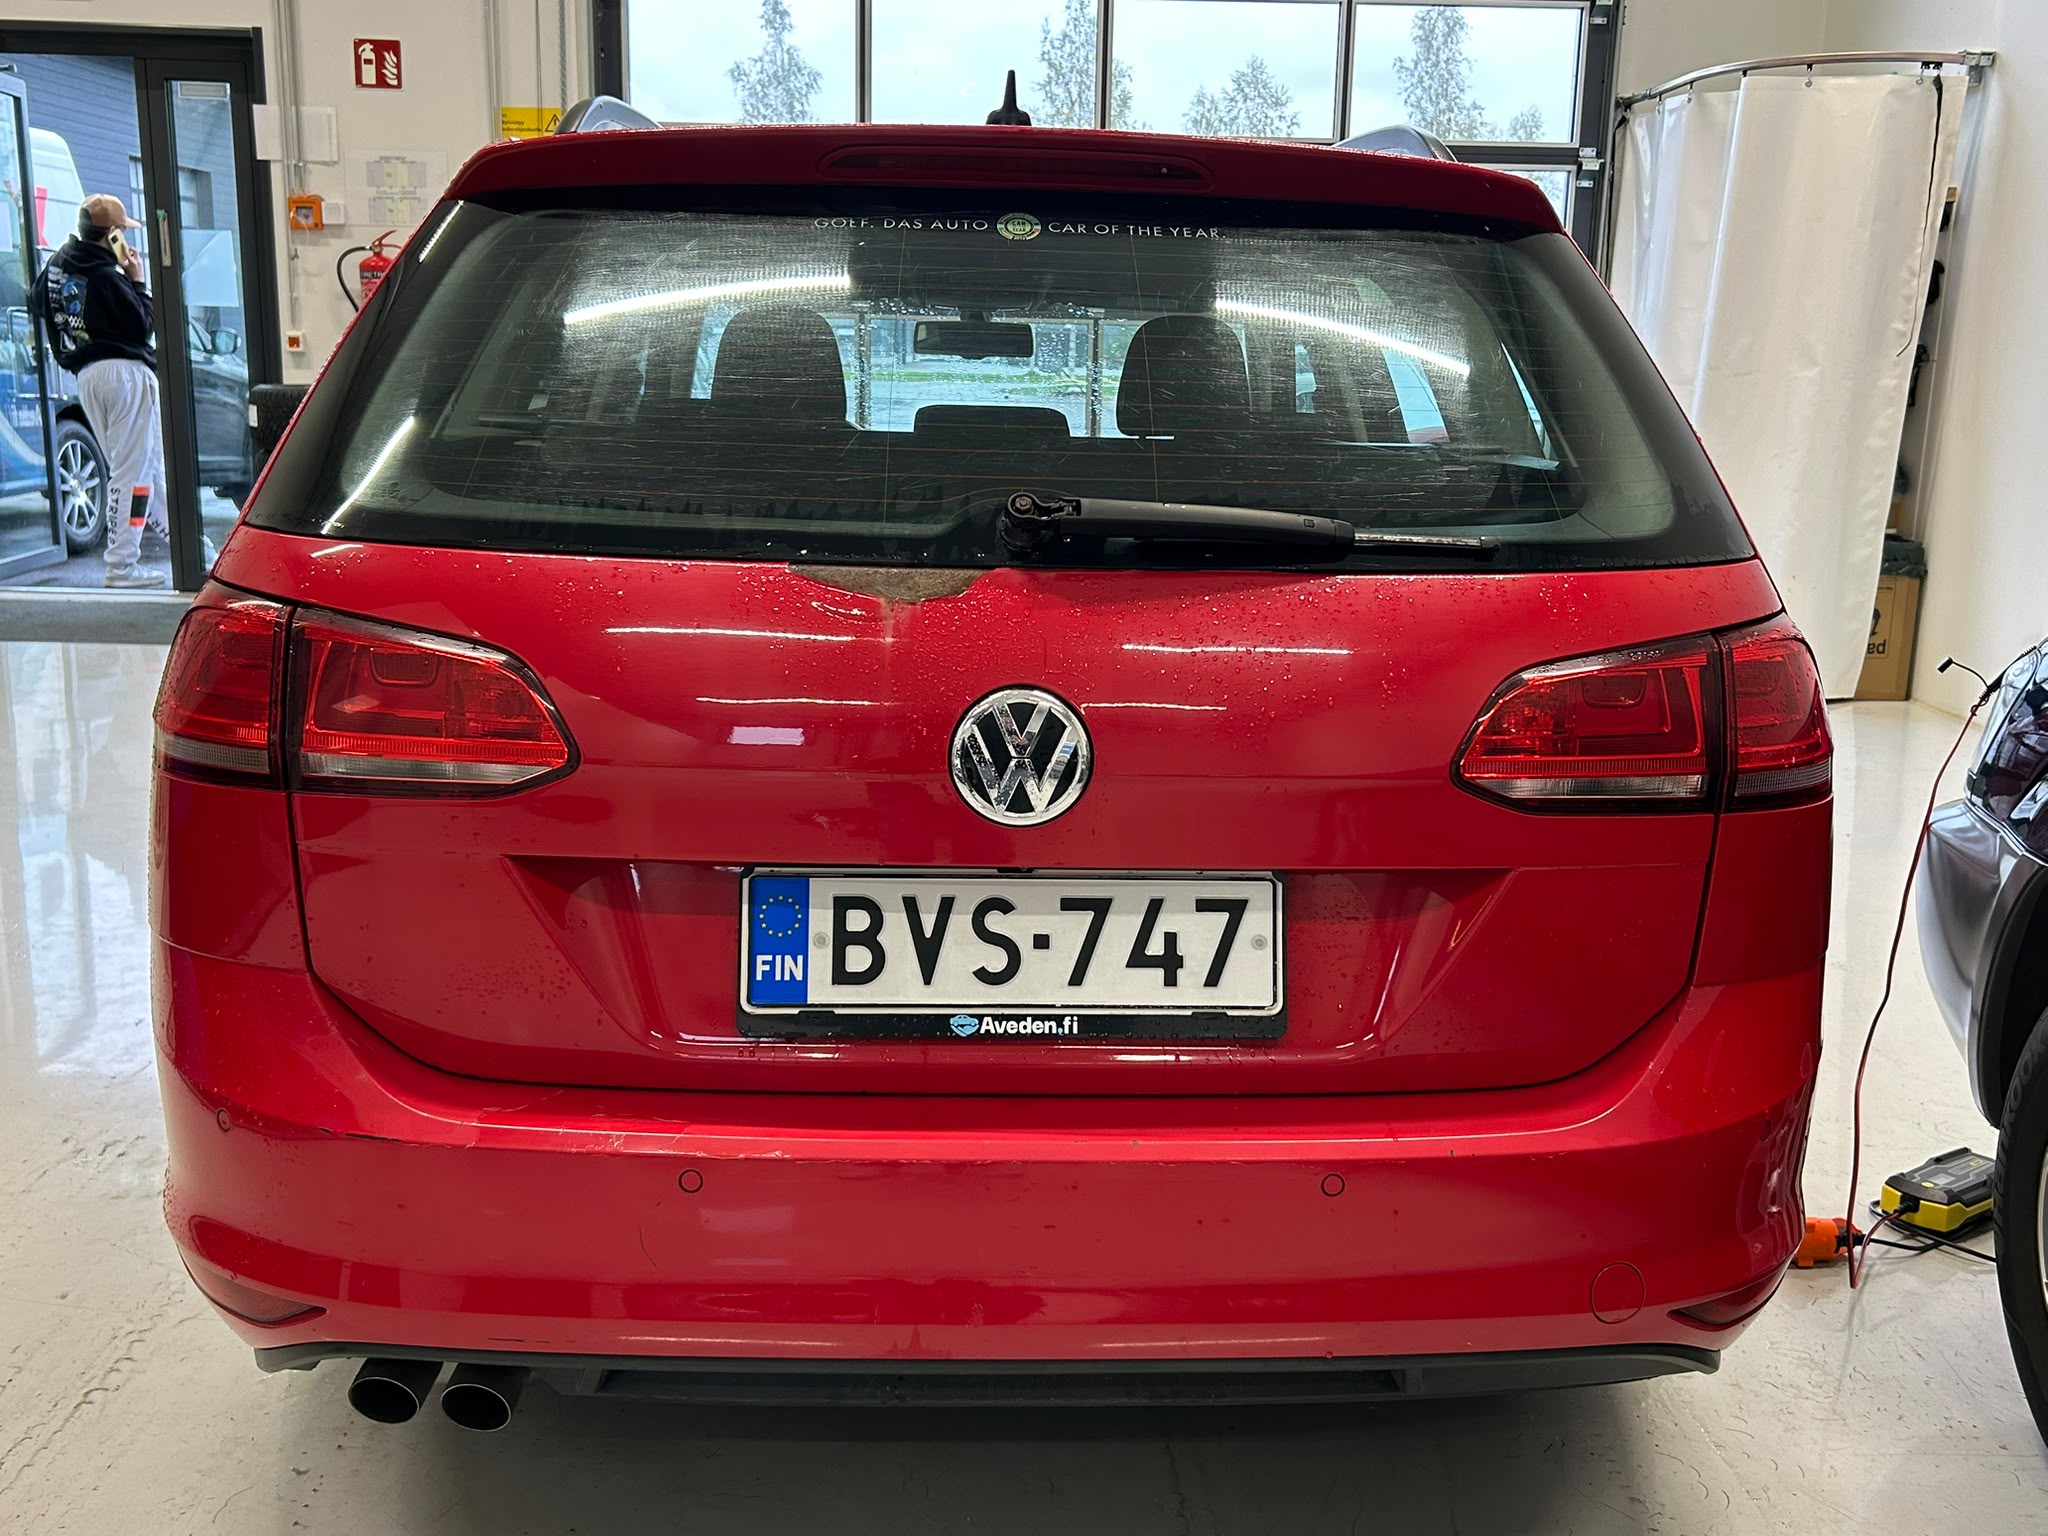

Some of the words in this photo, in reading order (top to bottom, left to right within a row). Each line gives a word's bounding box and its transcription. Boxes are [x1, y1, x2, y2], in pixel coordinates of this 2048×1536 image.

[883, 218, 923, 230] DAS
[930, 219, 989, 231] AUTO
[1048, 222, 1088, 234] CAR
[1094, 223, 1120, 235] OF
[1126, 224, 1163, 237] THE
[1169, 226, 1226, 239] YEAR.
[831, 894, 1250, 988] BVS-747
[755, 954, 804, 981] FIN
[979, 1016, 1079, 1036] Aveden.fi
